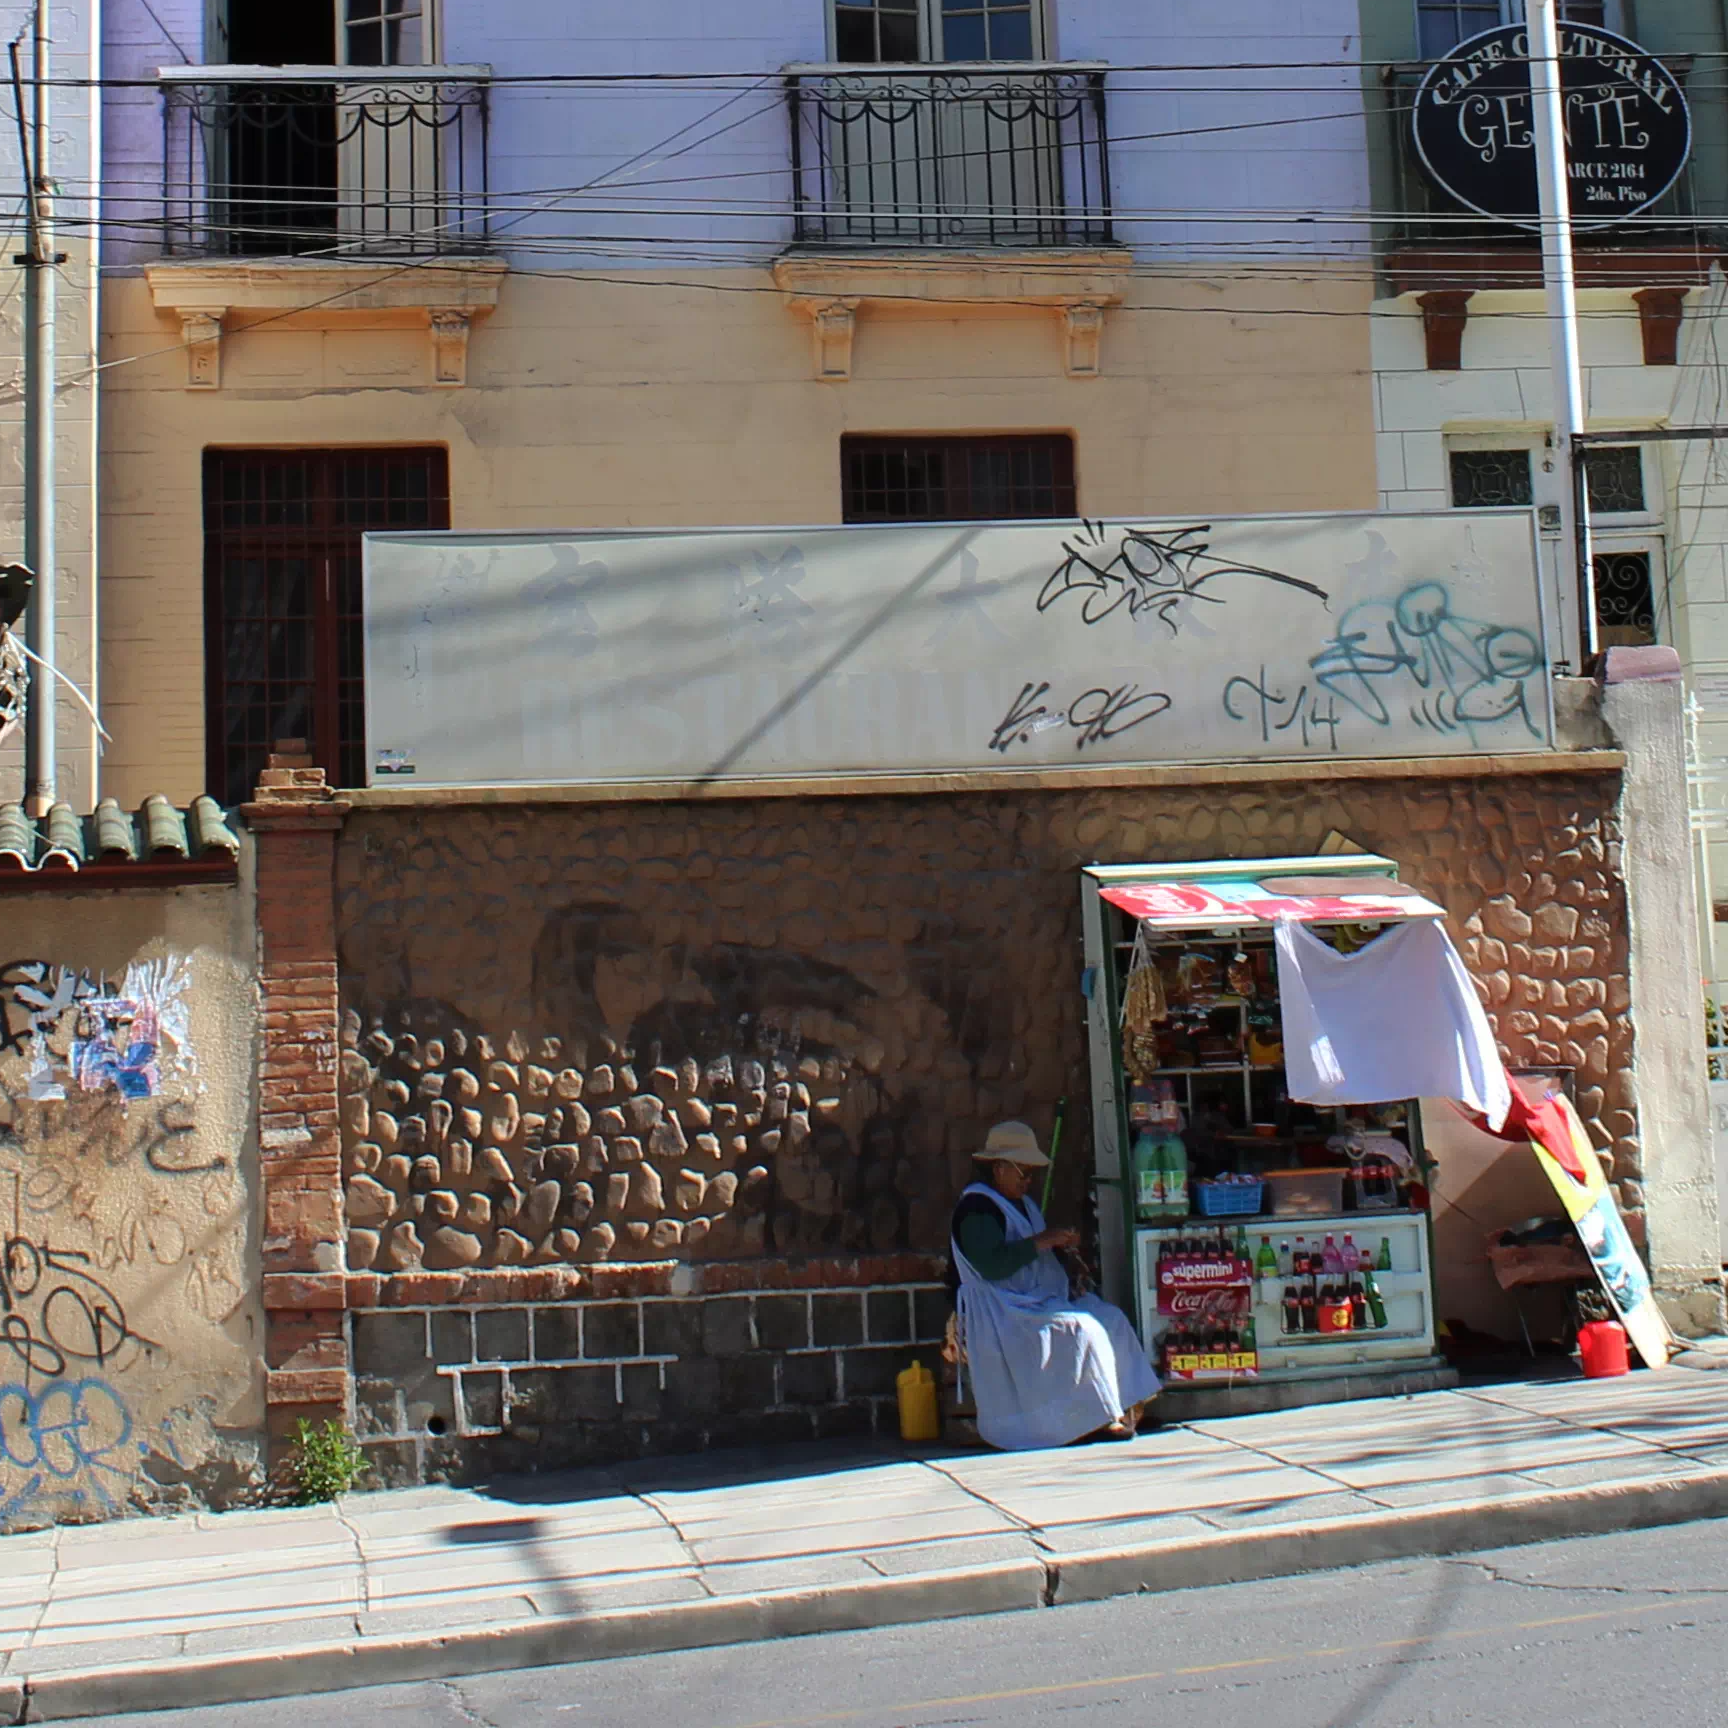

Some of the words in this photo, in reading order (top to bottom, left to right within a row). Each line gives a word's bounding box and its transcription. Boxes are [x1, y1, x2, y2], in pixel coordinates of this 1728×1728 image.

[1432, 39, 1507, 106] CAFE
[1512, 30, 1674, 115] CLTURAL
[1610, 162, 1646, 179] 2164
[1617, 185, 1648, 202] Piso
